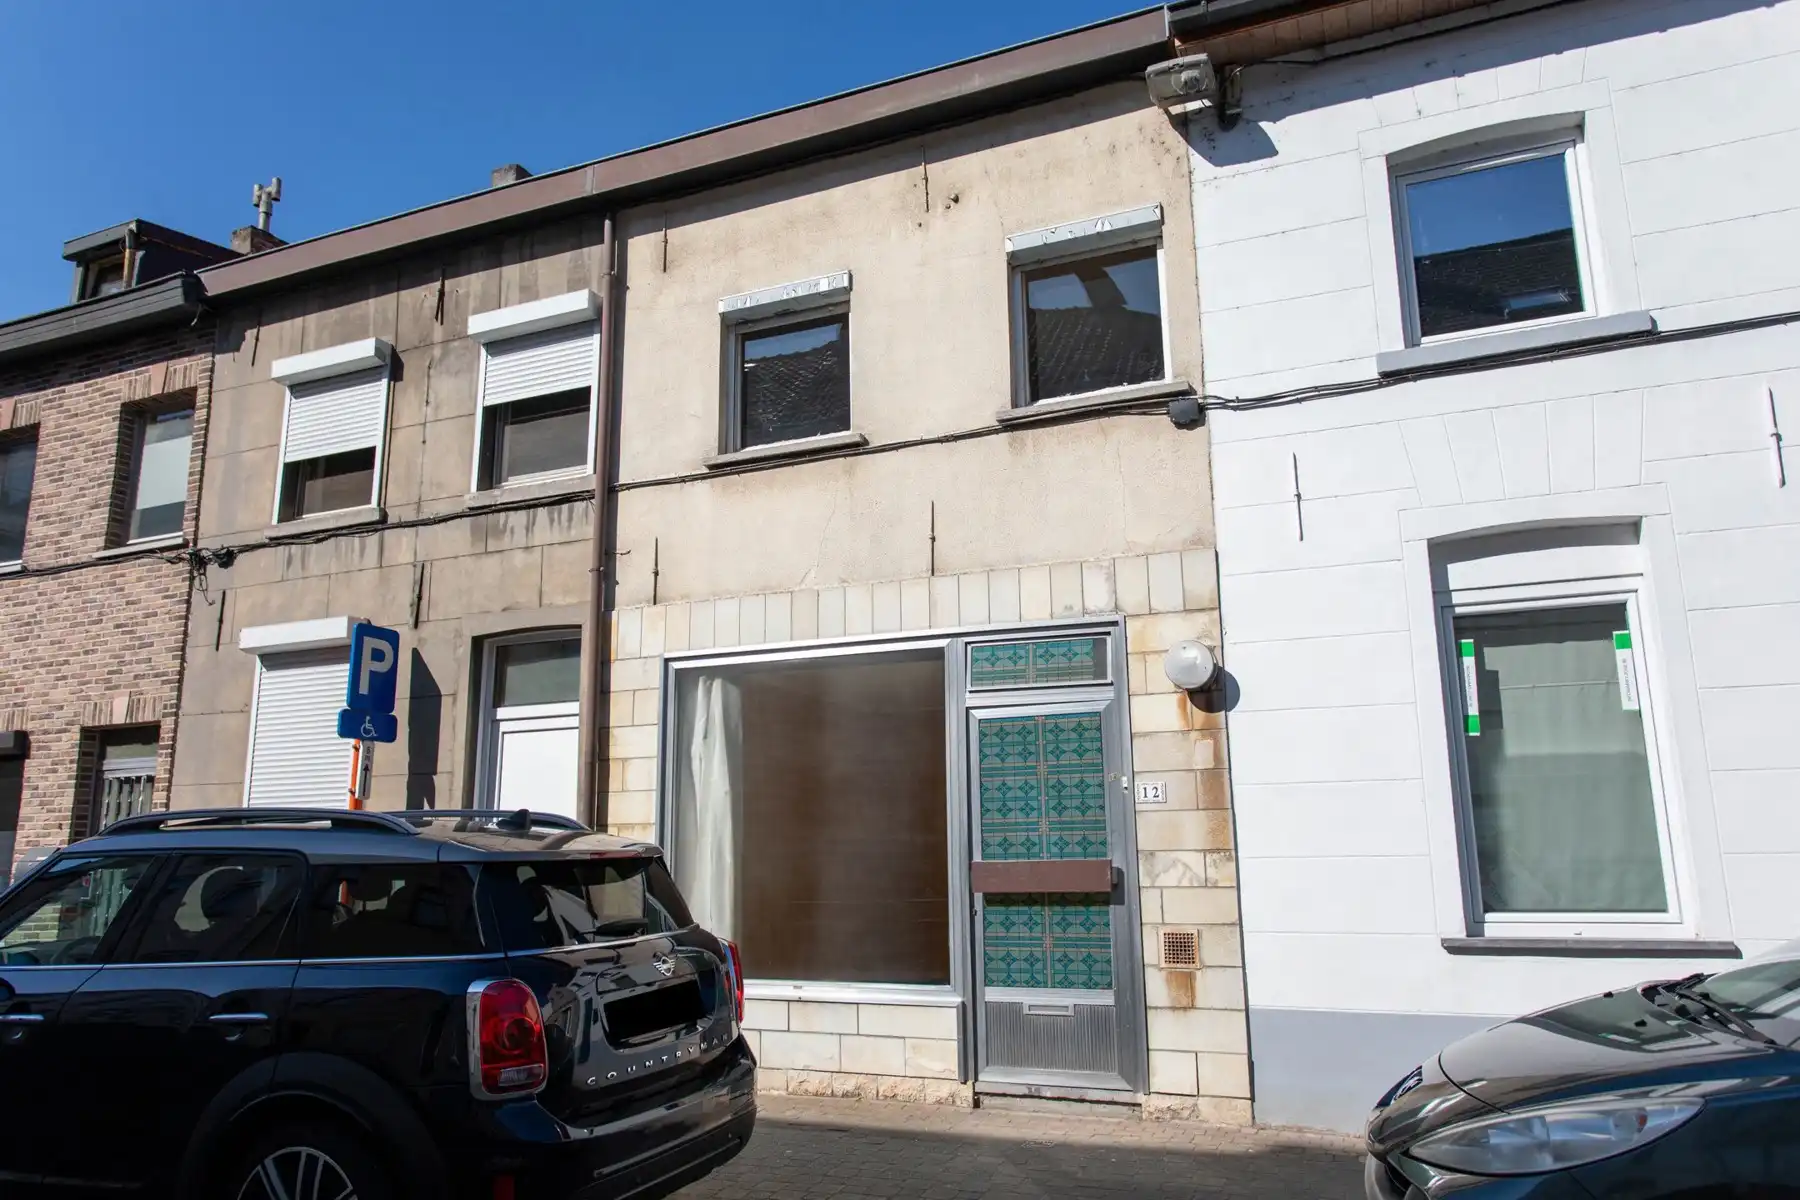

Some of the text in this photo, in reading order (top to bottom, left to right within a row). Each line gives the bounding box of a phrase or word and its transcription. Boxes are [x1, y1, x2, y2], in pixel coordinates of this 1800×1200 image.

[359, 635, 394, 695] P
[1142, 786, 1160, 799] 12
[586, 1032, 729, 1086] COUNTRYMAN
